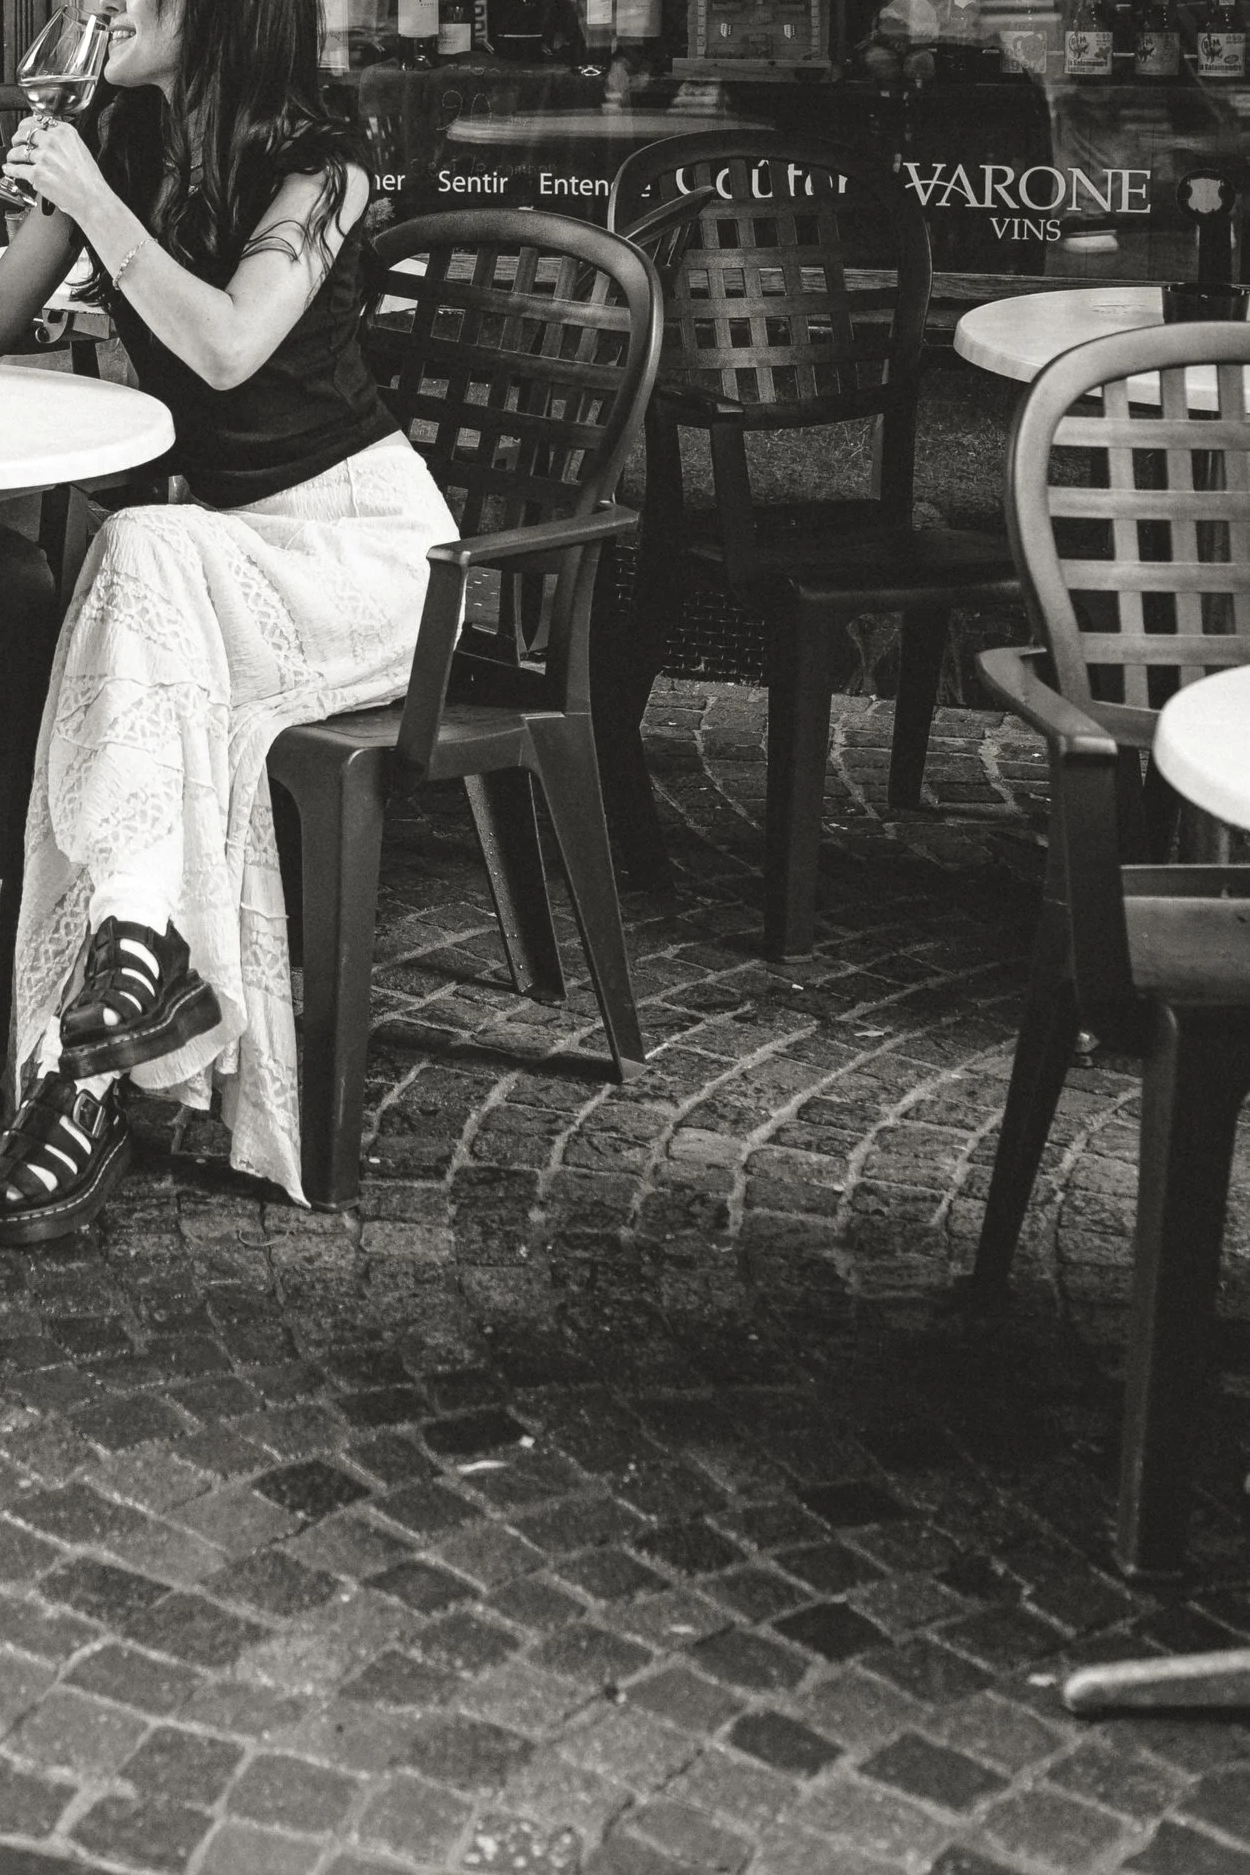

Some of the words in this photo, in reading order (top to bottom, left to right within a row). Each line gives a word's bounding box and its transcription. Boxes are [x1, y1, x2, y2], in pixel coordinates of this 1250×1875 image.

[438, 170, 509, 194] Sentir
[903, 162, 1152, 215] VARONE
[990, 218, 1062, 242] VINS
